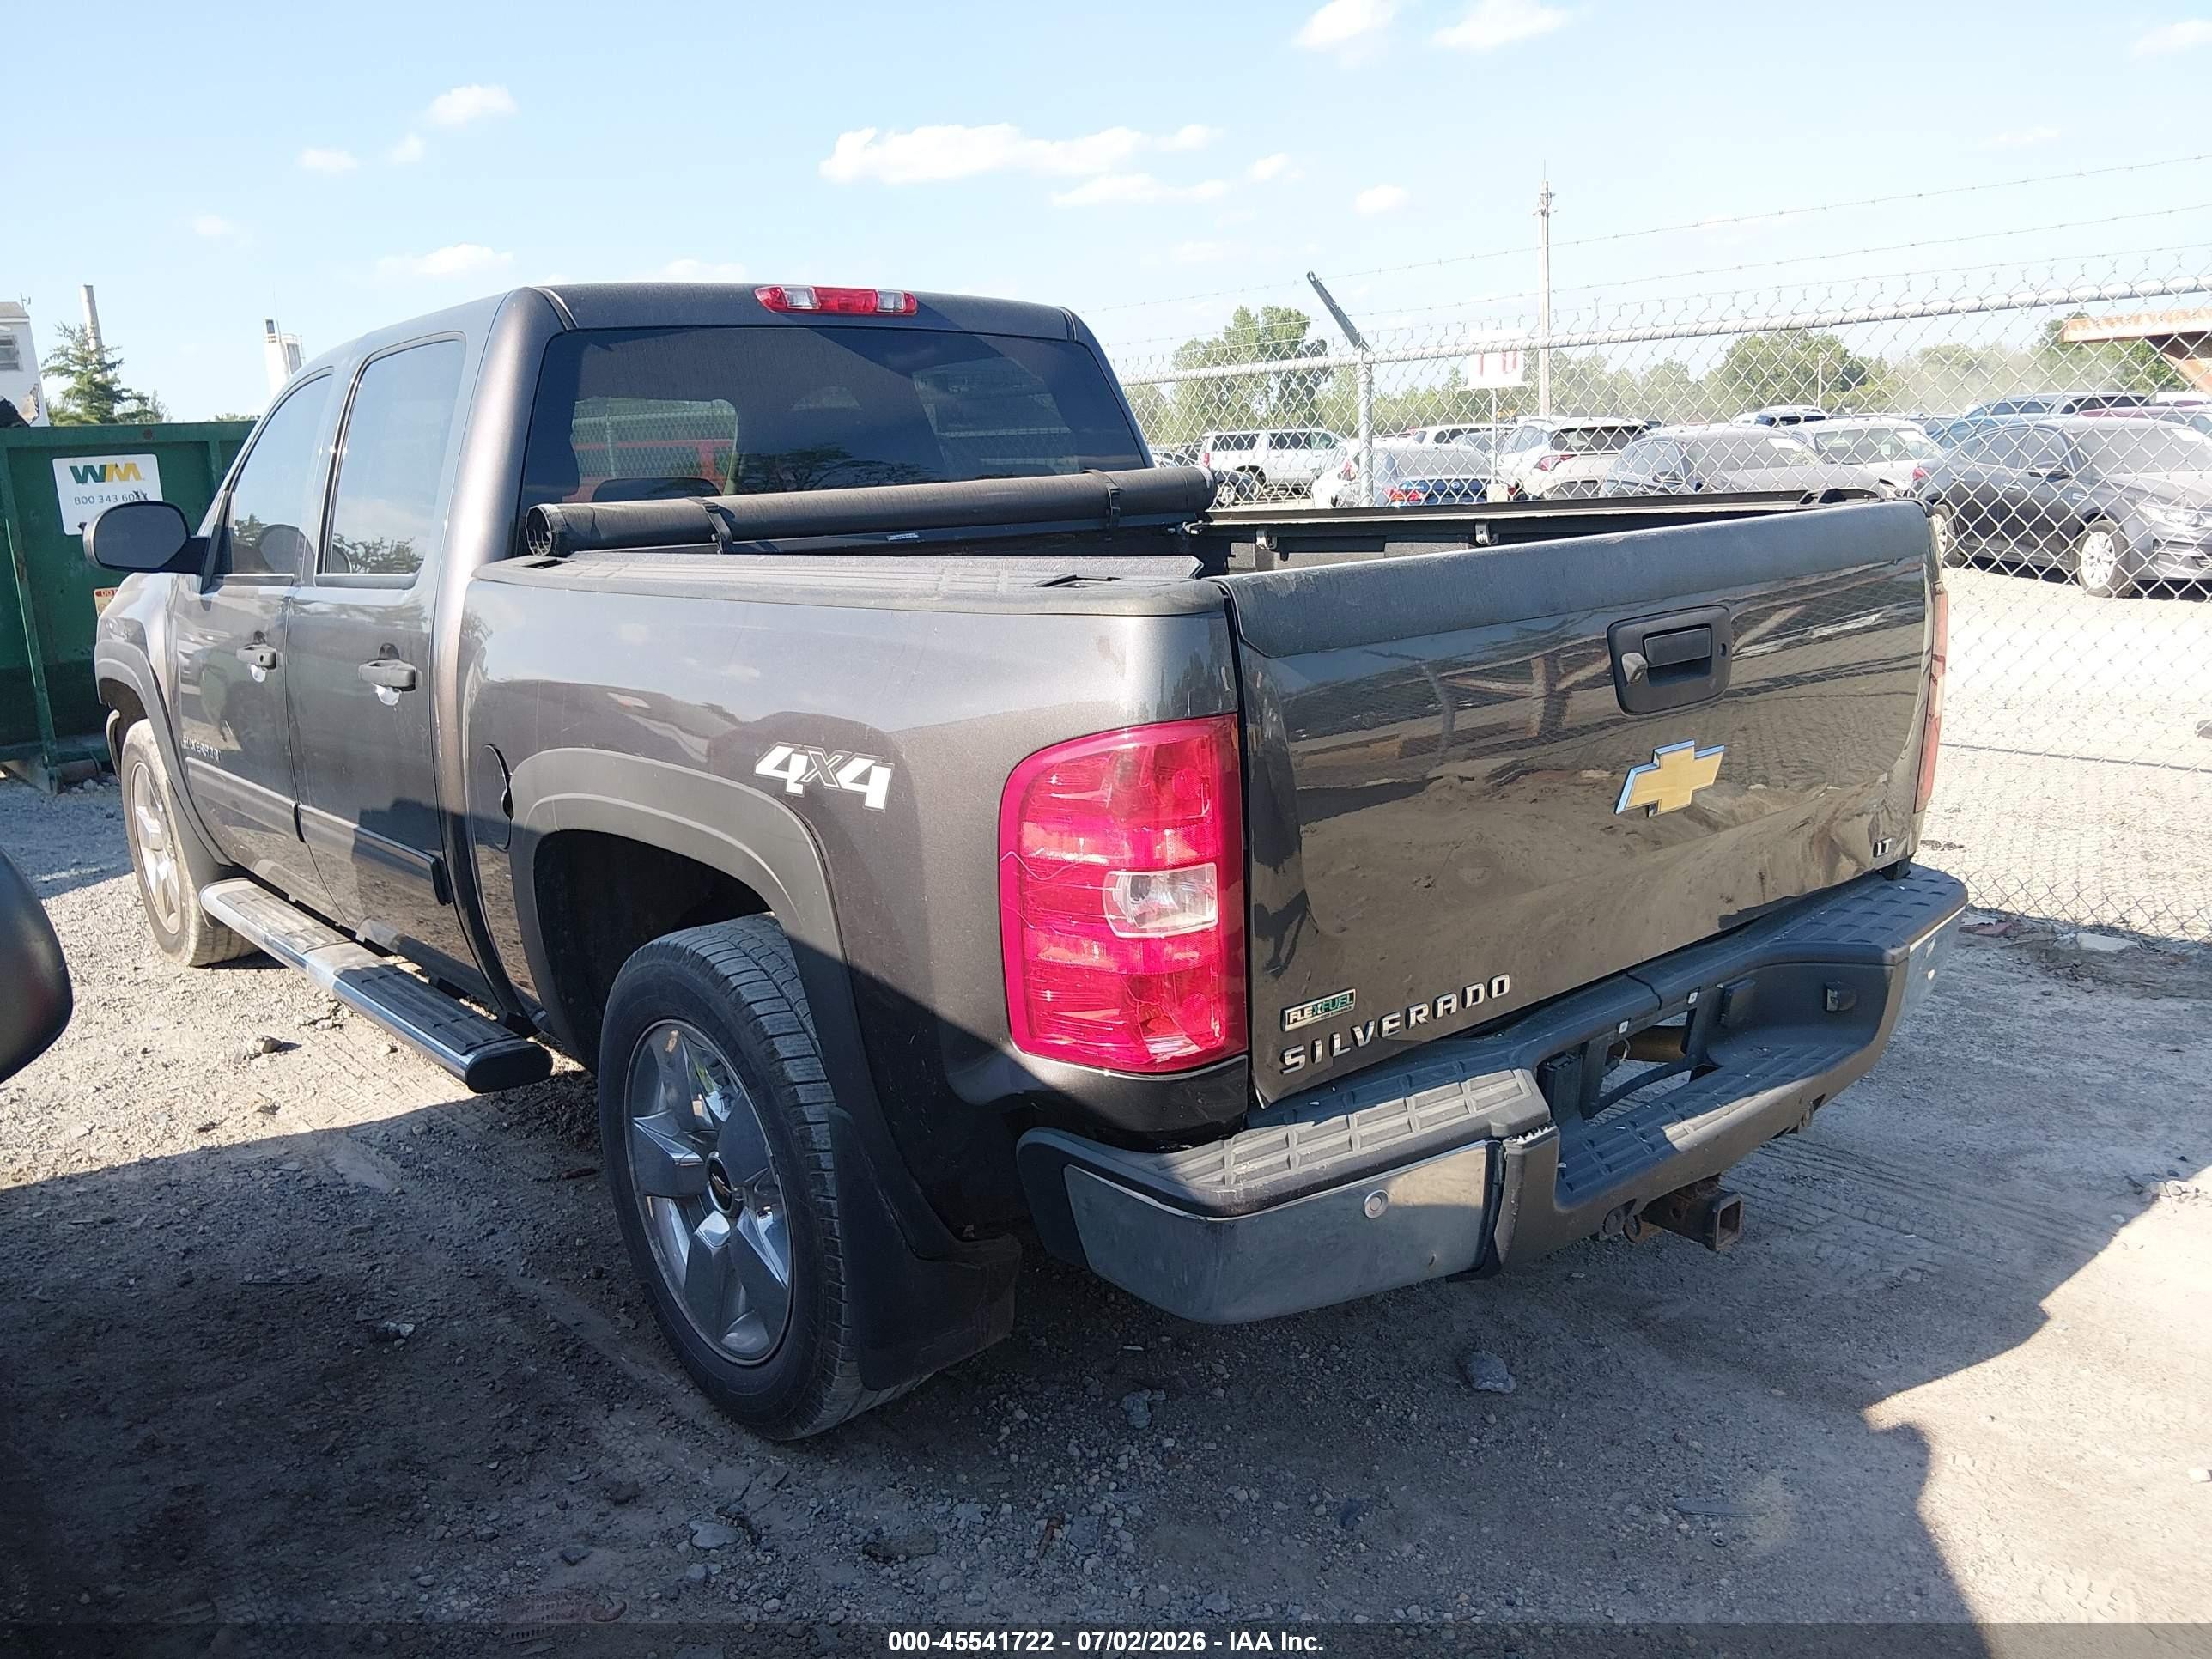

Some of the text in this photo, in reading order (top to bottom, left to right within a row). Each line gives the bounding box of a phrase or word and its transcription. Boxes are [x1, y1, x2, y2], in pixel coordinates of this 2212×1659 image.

[69, 462, 143, 484] WM
[74, 495, 95, 505] 800
[99, 494, 118, 503] 343
[1279, 973, 1510, 1074] SILVERADO
